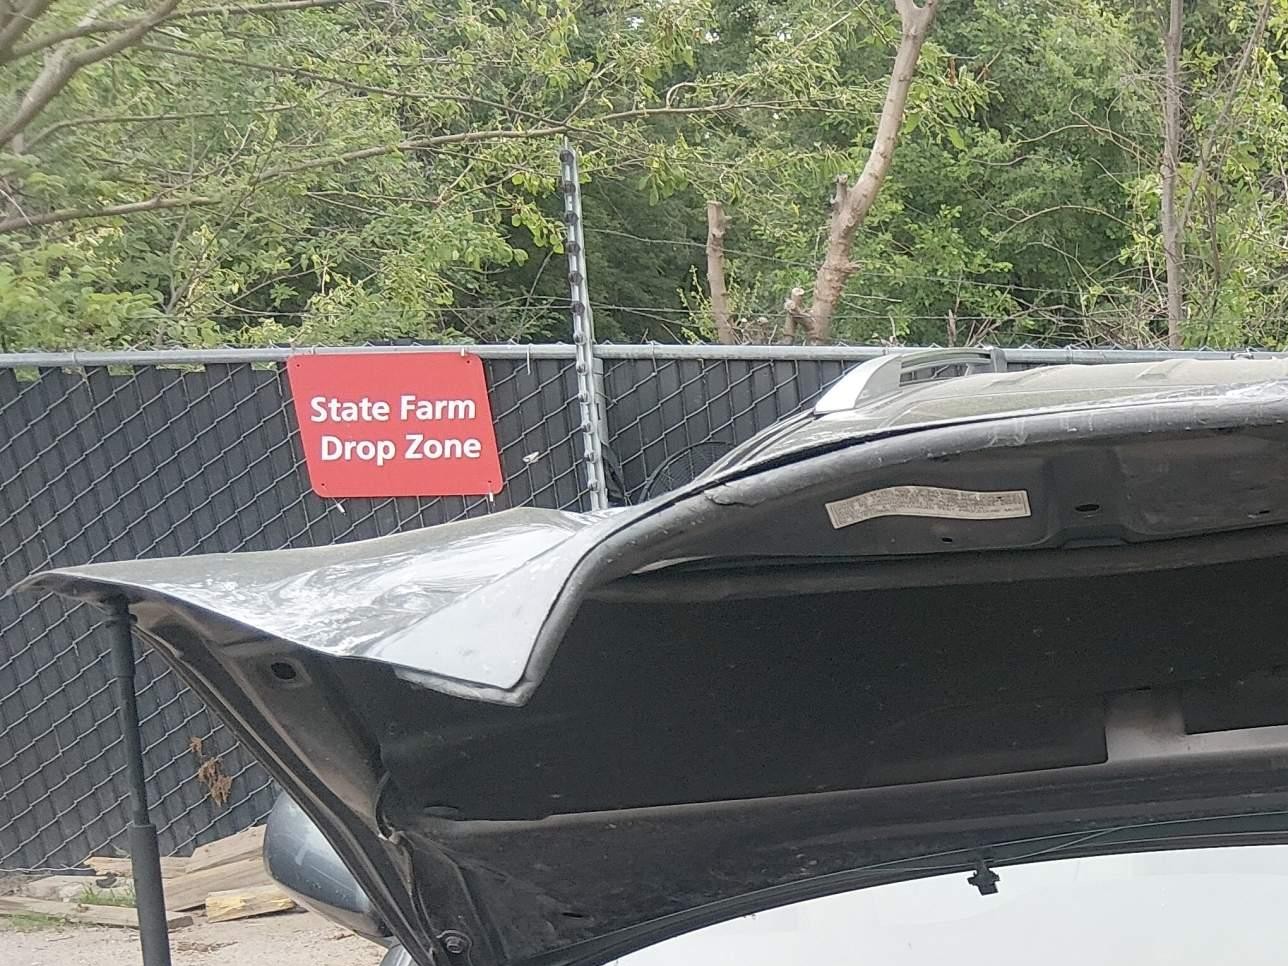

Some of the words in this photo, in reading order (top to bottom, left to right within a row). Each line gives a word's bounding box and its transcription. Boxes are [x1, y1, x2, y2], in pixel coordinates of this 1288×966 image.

[310, 396, 390, 423] State
[400, 394, 475, 421] Farm
[321, 435, 395, 466] Drop
[405, 434, 481, 459] Zone
